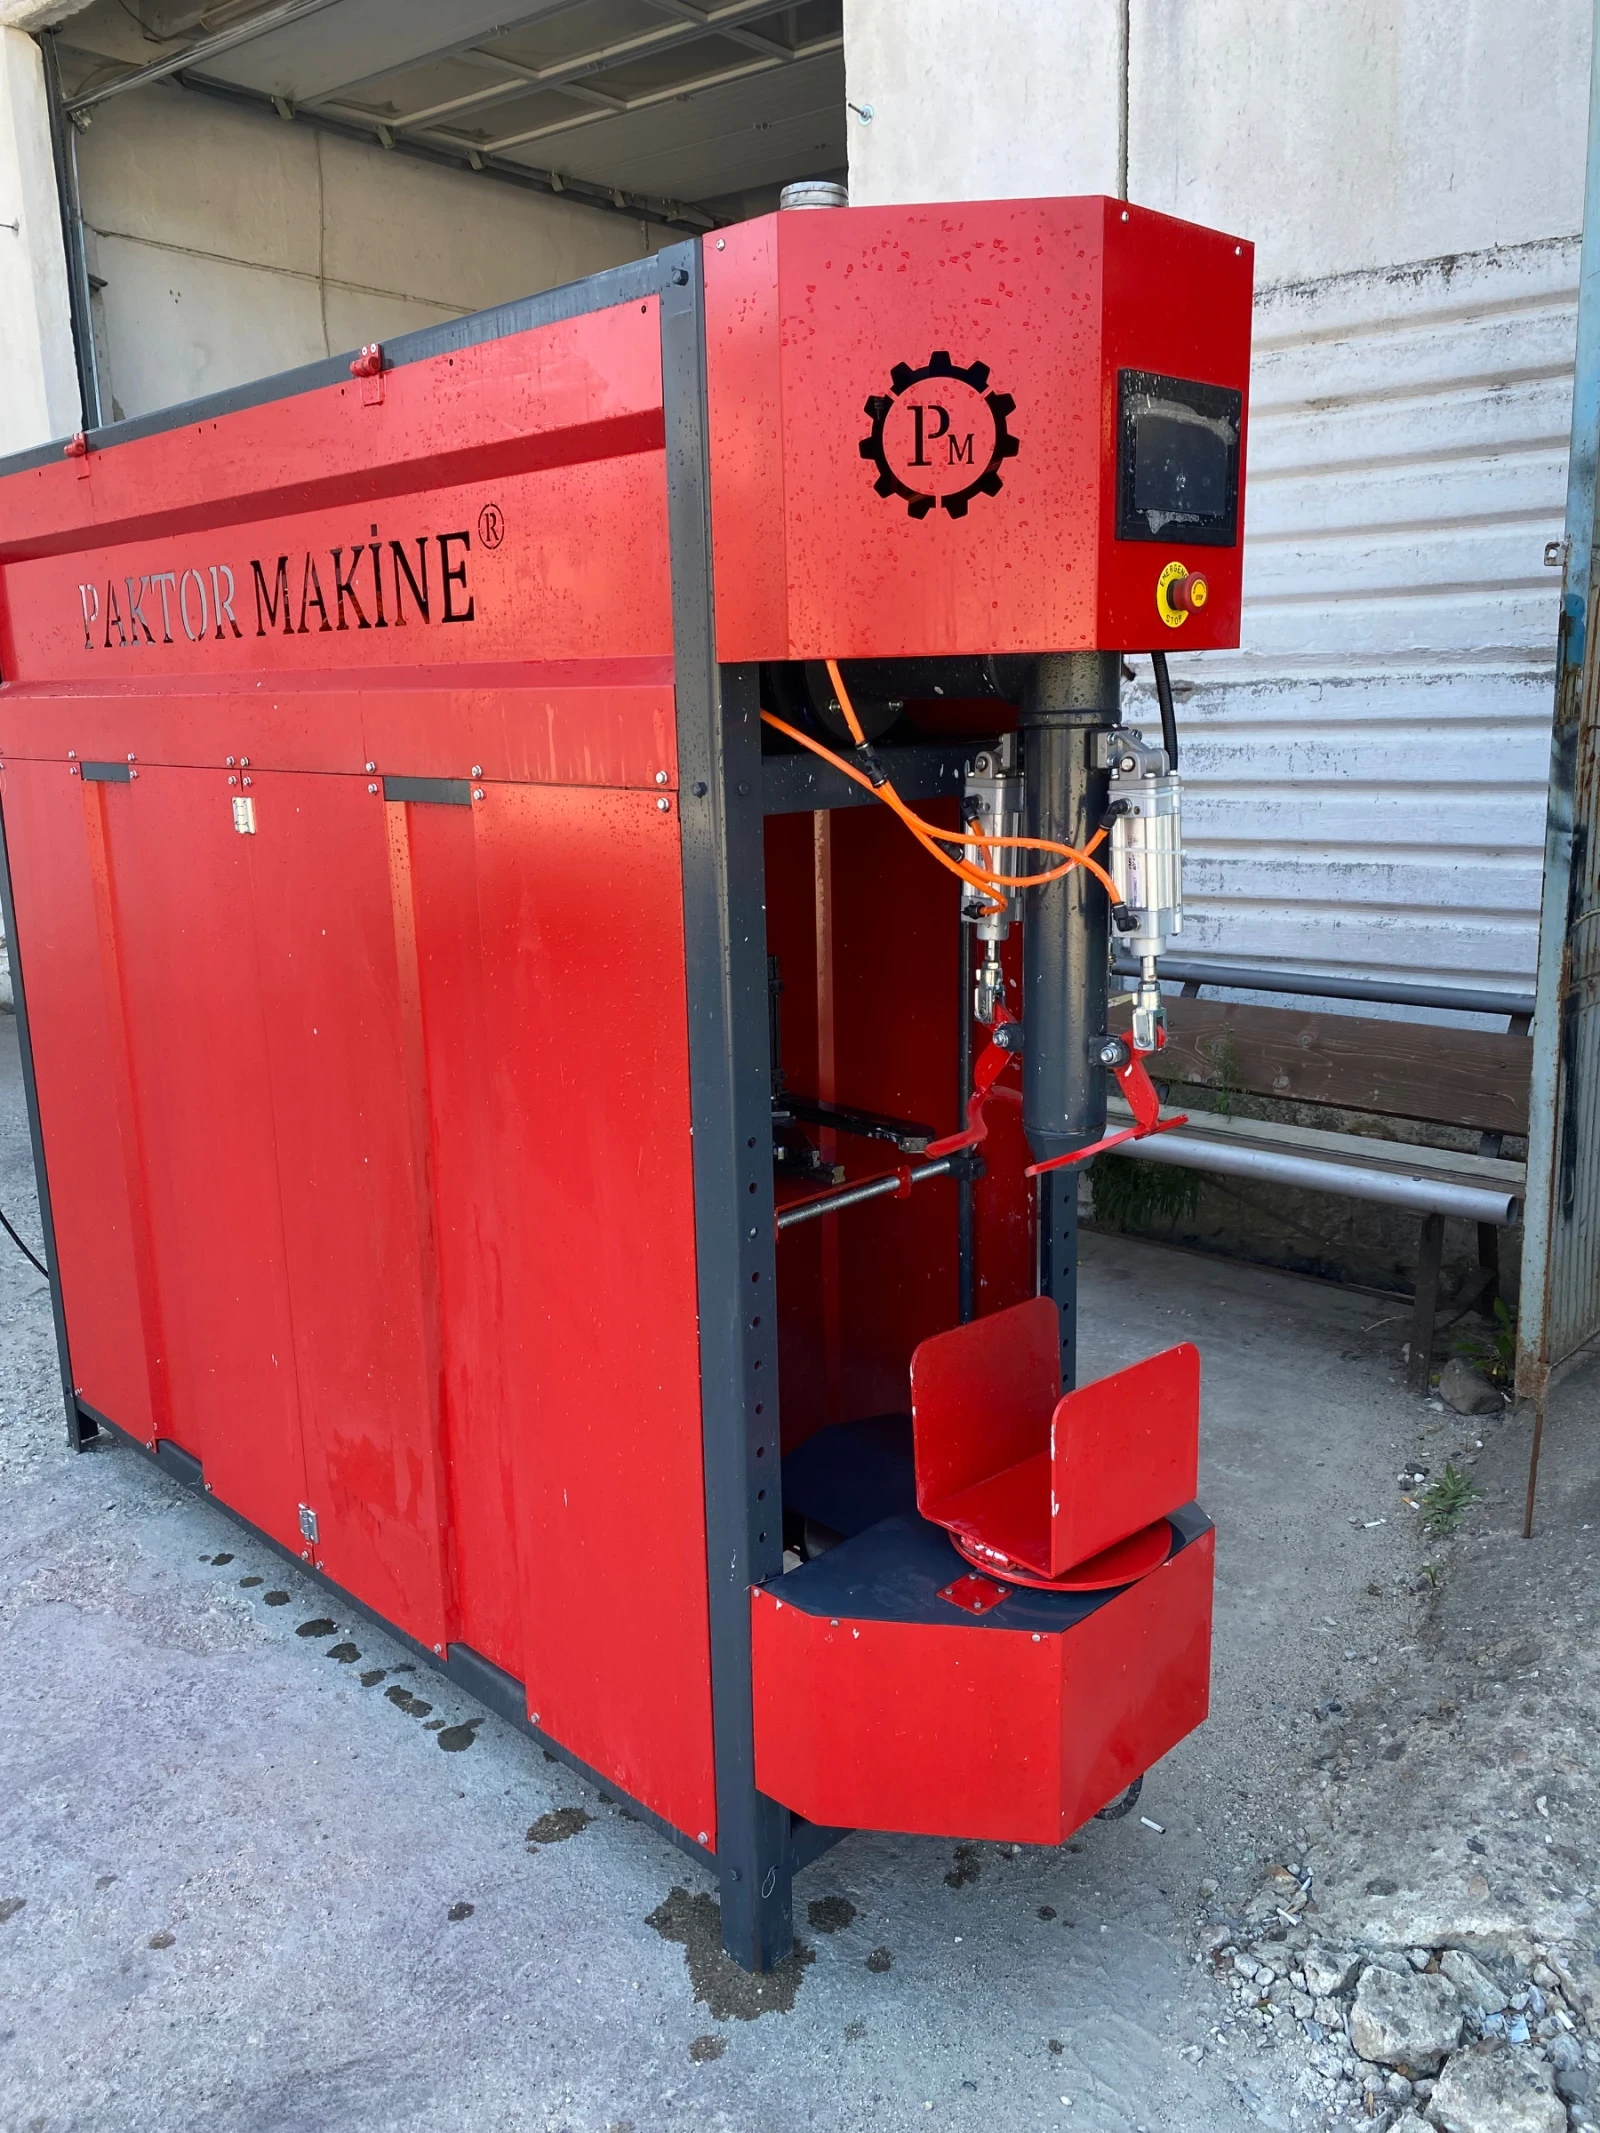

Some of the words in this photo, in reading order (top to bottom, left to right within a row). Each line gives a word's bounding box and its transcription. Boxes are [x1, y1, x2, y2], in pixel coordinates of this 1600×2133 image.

[906, 404, 975, 467] PM
[1160, 563, 1188, 587] EMERGENC
[77, 564, 244, 650] PAKTOR
[1165, 614, 1182, 625] STOP
